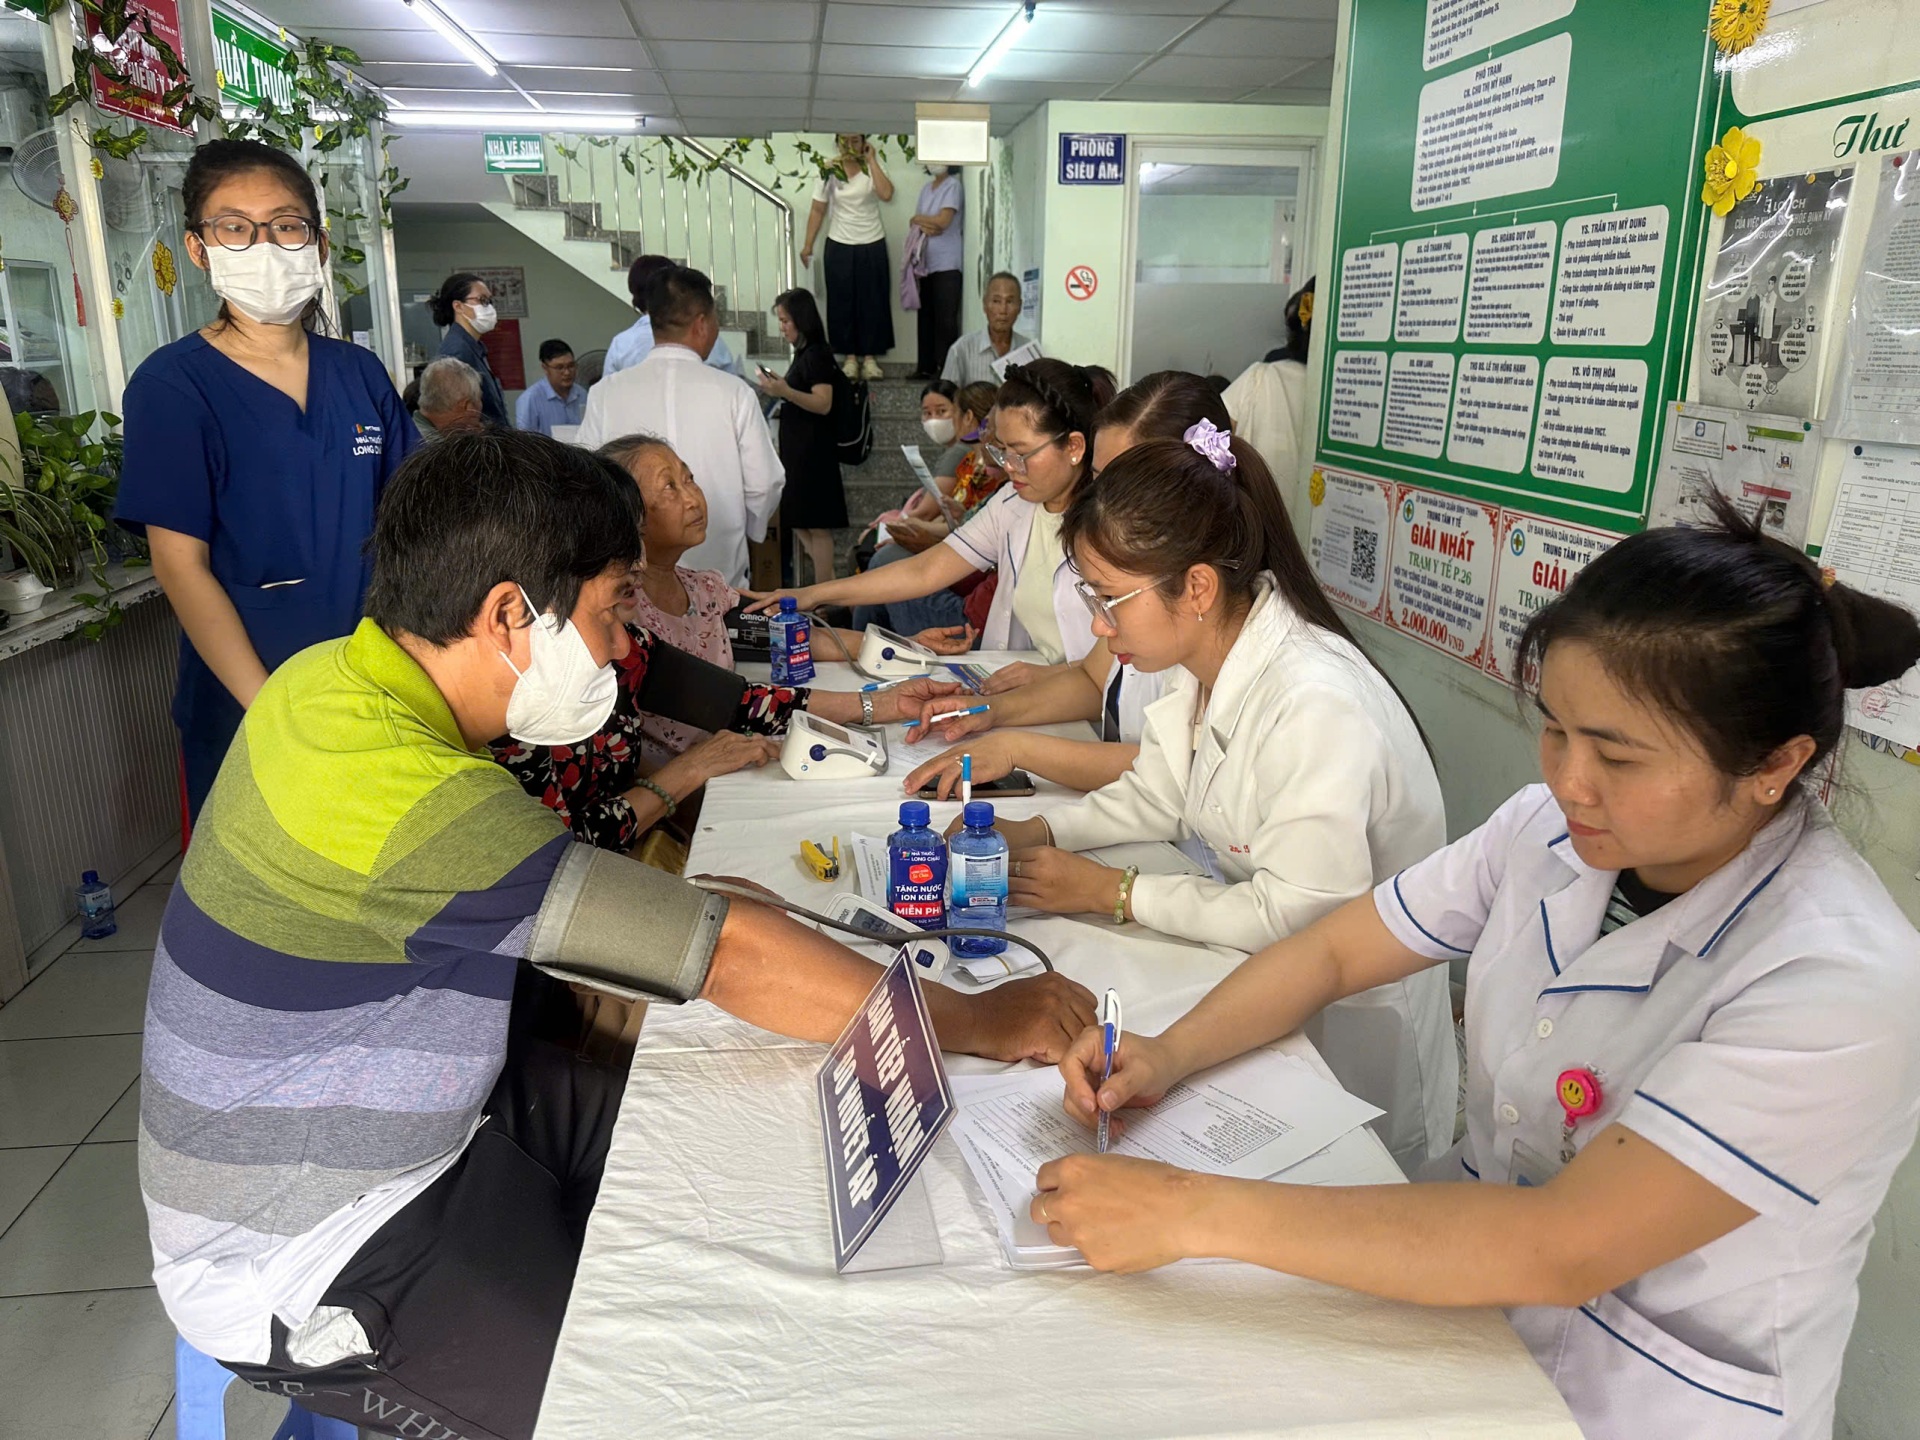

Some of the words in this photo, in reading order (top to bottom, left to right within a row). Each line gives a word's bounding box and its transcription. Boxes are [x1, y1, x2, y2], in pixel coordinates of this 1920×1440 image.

[487, 136, 505, 155] NHÀ
[520, 140, 540, 156] SINH
[1071, 138, 1114, 157] PHÒNG
[1833, 112, 1910, 158] Thư
[1066, 161, 1095, 179] SIÊU
[1098, 161, 1118, 179] ÂM
[1630, 217, 1646, 229] DUNG
[353, 445, 374, 456] LONG
[1411, 521, 1436, 550] GIẢI
[1439, 530, 1475, 562] NHẤT
[1543, 542, 1562, 559] TRUNG
[1564, 546, 1576, 561] TÂM
[1409, 551, 1431, 572] TRẠM
[1532, 559, 1567, 593] GIẢI
[1401, 607, 1447, 644] 2.000.000
[1448, 634, 1464, 652] VNĐ
[895, 885, 918, 894] TẶNG
[921, 884, 941, 892] NƯỚC
[896, 904, 922, 915] MIỄN
[867, 983, 895, 1046] BÀN
[874, 1023, 911, 1090] TIẾP
[837, 1076, 876, 1172] HUYẾT
[884, 1073, 925, 1171] NHẬN
[848, 1153, 878, 1209] ÁP
